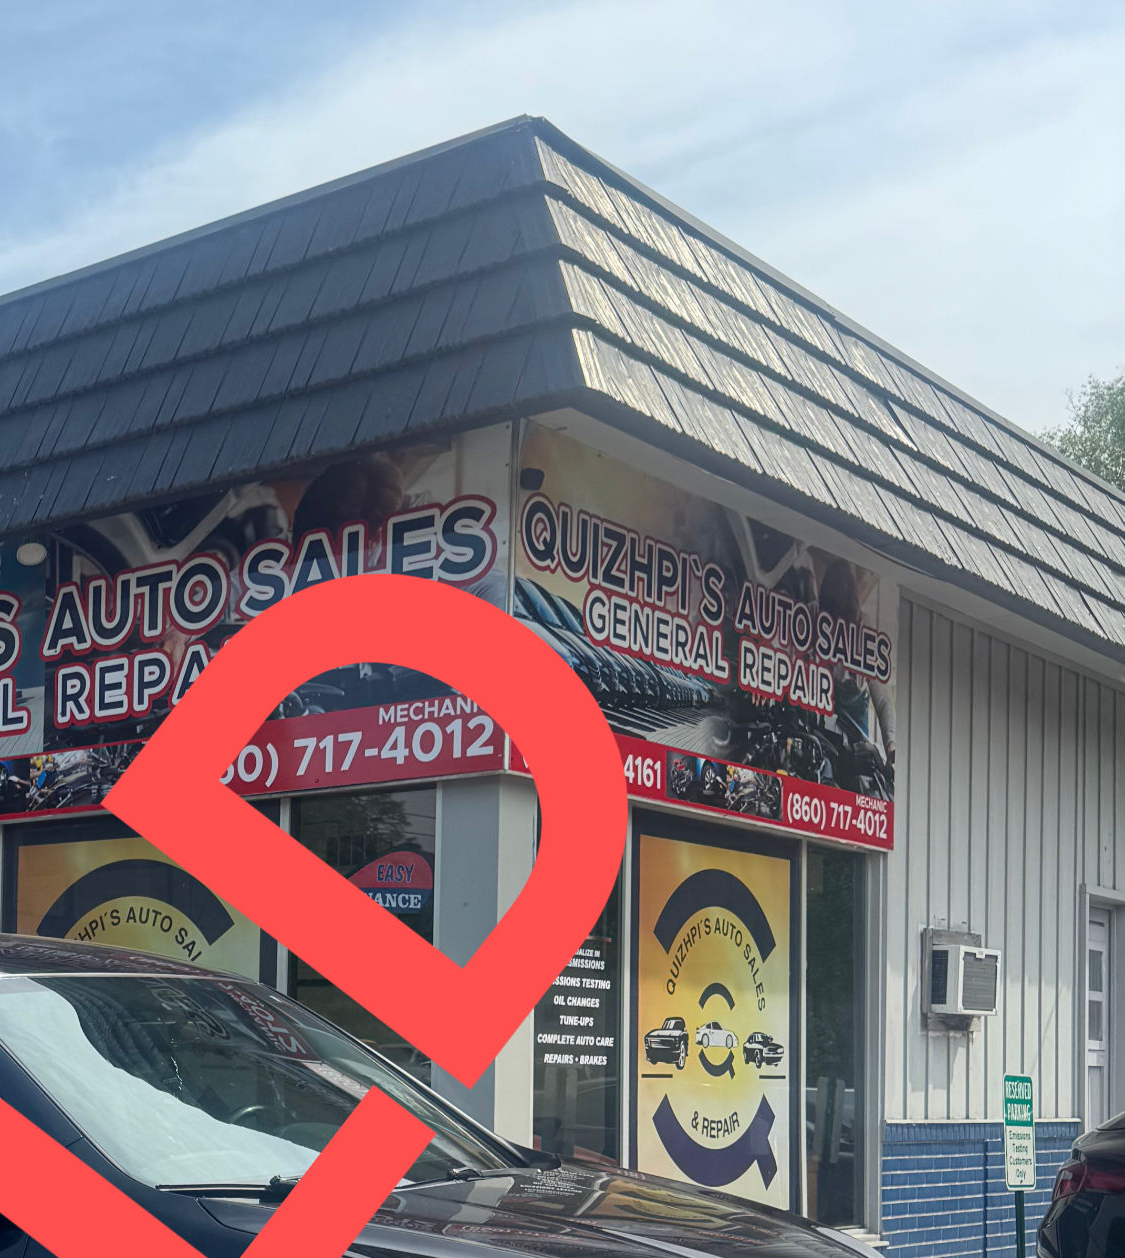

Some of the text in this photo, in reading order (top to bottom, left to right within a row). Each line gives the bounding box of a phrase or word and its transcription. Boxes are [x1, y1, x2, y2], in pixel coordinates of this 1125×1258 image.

[42, 556, 228, 656] AUTO
[240, 500, 494, 618] SALES
[736, 584, 811, 651] AUTO
[817, 614, 891, 682] SALES
[585, 591, 834, 712] GENERAL REPAIR
[58, 642, 219, 723] REPA
[378, 697, 480, 725] MECHANI
[294, 715, 494, 776] 717-4012
[624, 754, 662, 790] 4161
[856, 794, 888, 813] MECHANIC
[787, 792, 888, 839] (860) 717-4012
[377, 863, 415, 884] EASY
[368, 892, 422, 909] ANCE
[125, 906, 173, 934] AUTO
[567, 958, 605, 970] SMISSIONS
[714, 917, 743, 948] AUTO
[743, 943, 766, 1012] SALES
[582, 978, 611, 990] TESTING
[553, 995, 600, 1008] OIL CHANGES
[559, 1015, 594, 1027] TUNE-UPS
[537, 1033, 614, 1047] COMPLETE AUTO CARE
[544, 1053, 608, 1066] REPAIRS BRAKES
[1005, 1081, 1032, 1100] RESERVED
[1007, 1103, 1032, 1122] PARKING
[691, 1110, 740, 1139] & REPAIR
[1012, 1143, 1029, 1155] Testing
[1009, 1156, 1032, 1166] Customers
[1015, 1169, 1027, 1180] Only
